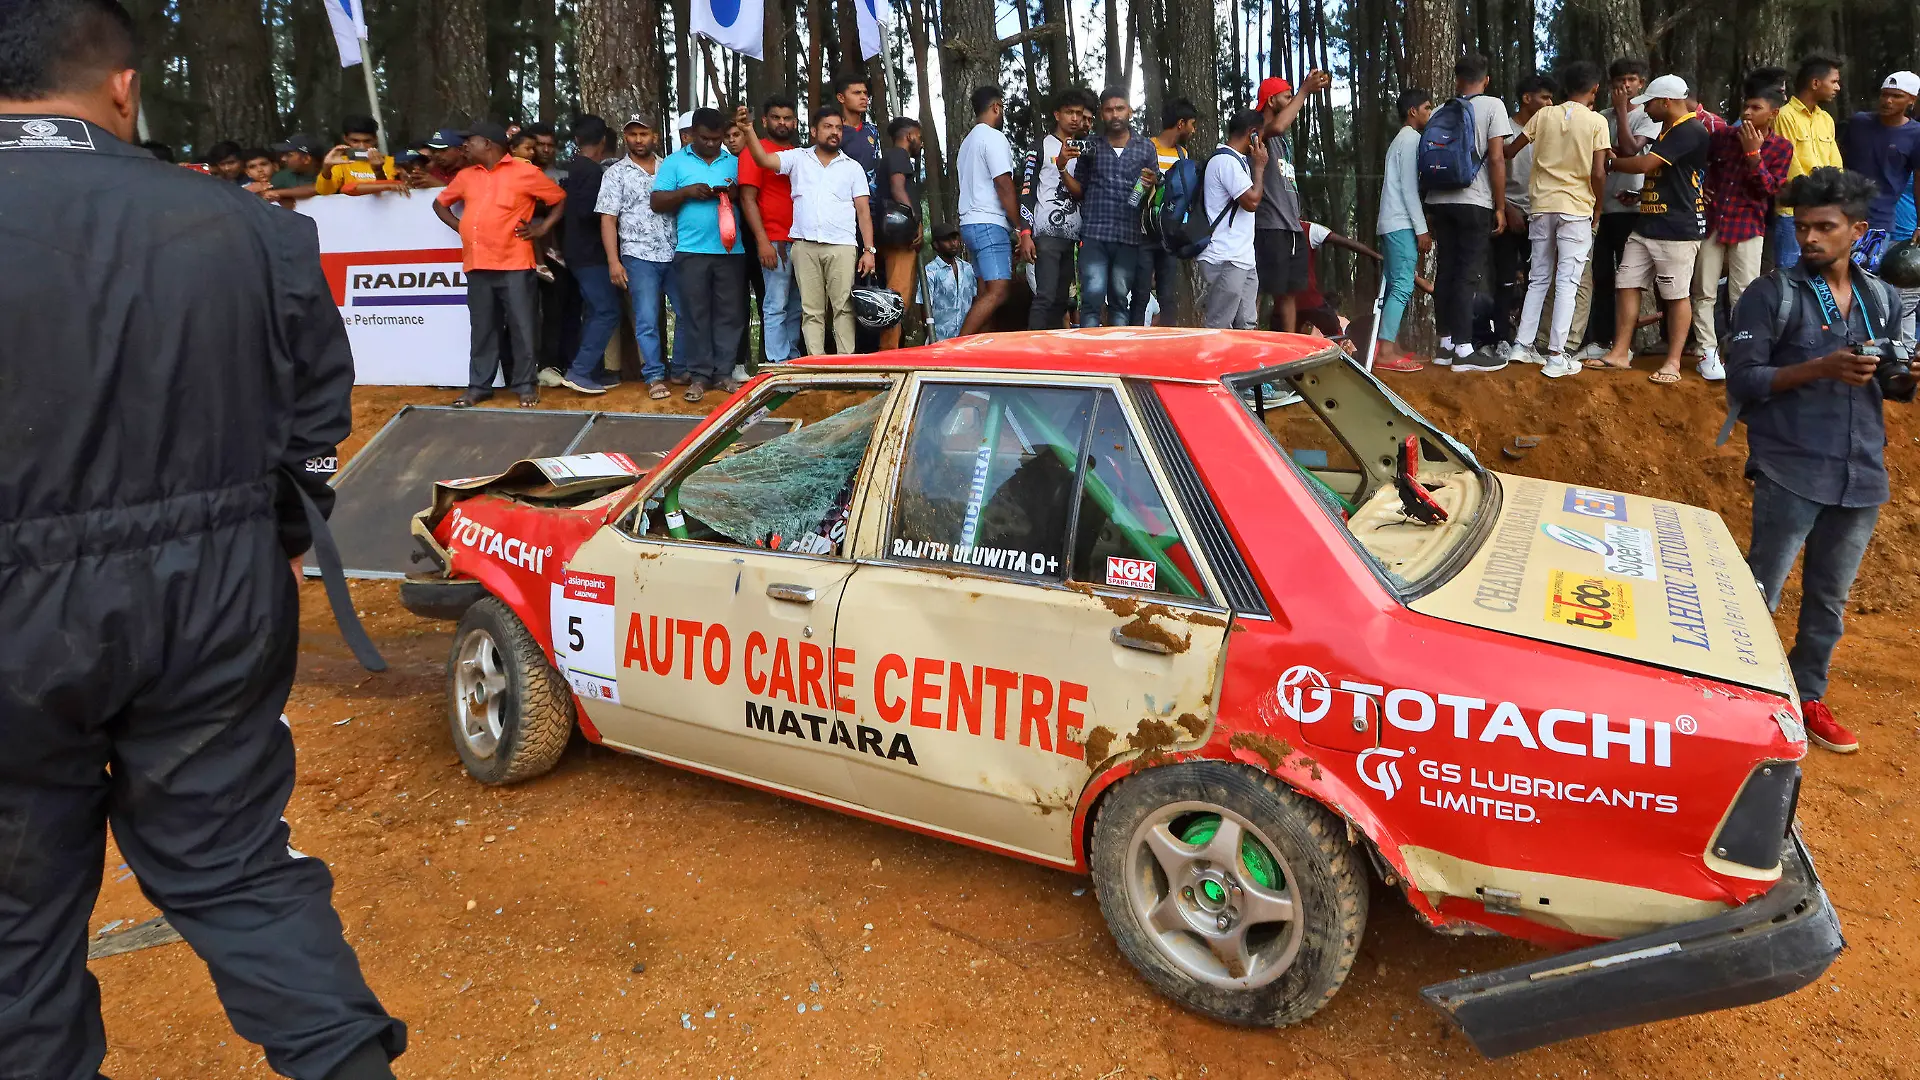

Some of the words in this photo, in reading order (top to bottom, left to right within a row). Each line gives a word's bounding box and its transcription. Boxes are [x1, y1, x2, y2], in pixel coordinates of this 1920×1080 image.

[352, 272, 468, 290] RADIAL
[354, 314, 424, 326] Performance
[452, 516, 545, 575] TOTACHI
[1652, 504, 1694, 578] AUTOMOBILES
[1108, 559, 1154, 583] NGK
[1108, 578, 1129, 586] SPARK
[1130, 581, 1153, 590] PLUGS
[1715, 571, 1736, 596] care
[568, 615, 585, 652] 5
[1664, 574, 1711, 652] LAHIRU
[1718, 598, 1759, 666] excellent
[623, 612, 731, 686] AUTO
[744, 630, 856, 714] CARE
[873, 653, 1089, 761] CENTRE
[745, 701, 919, 766] MATARA
[1340, 680, 1671, 768] TOTACHI
[1418, 759, 1462, 784] GS
[1470, 767, 1678, 814] LUBRICANTS
[1420, 786, 1542, 824] LIMITED.
